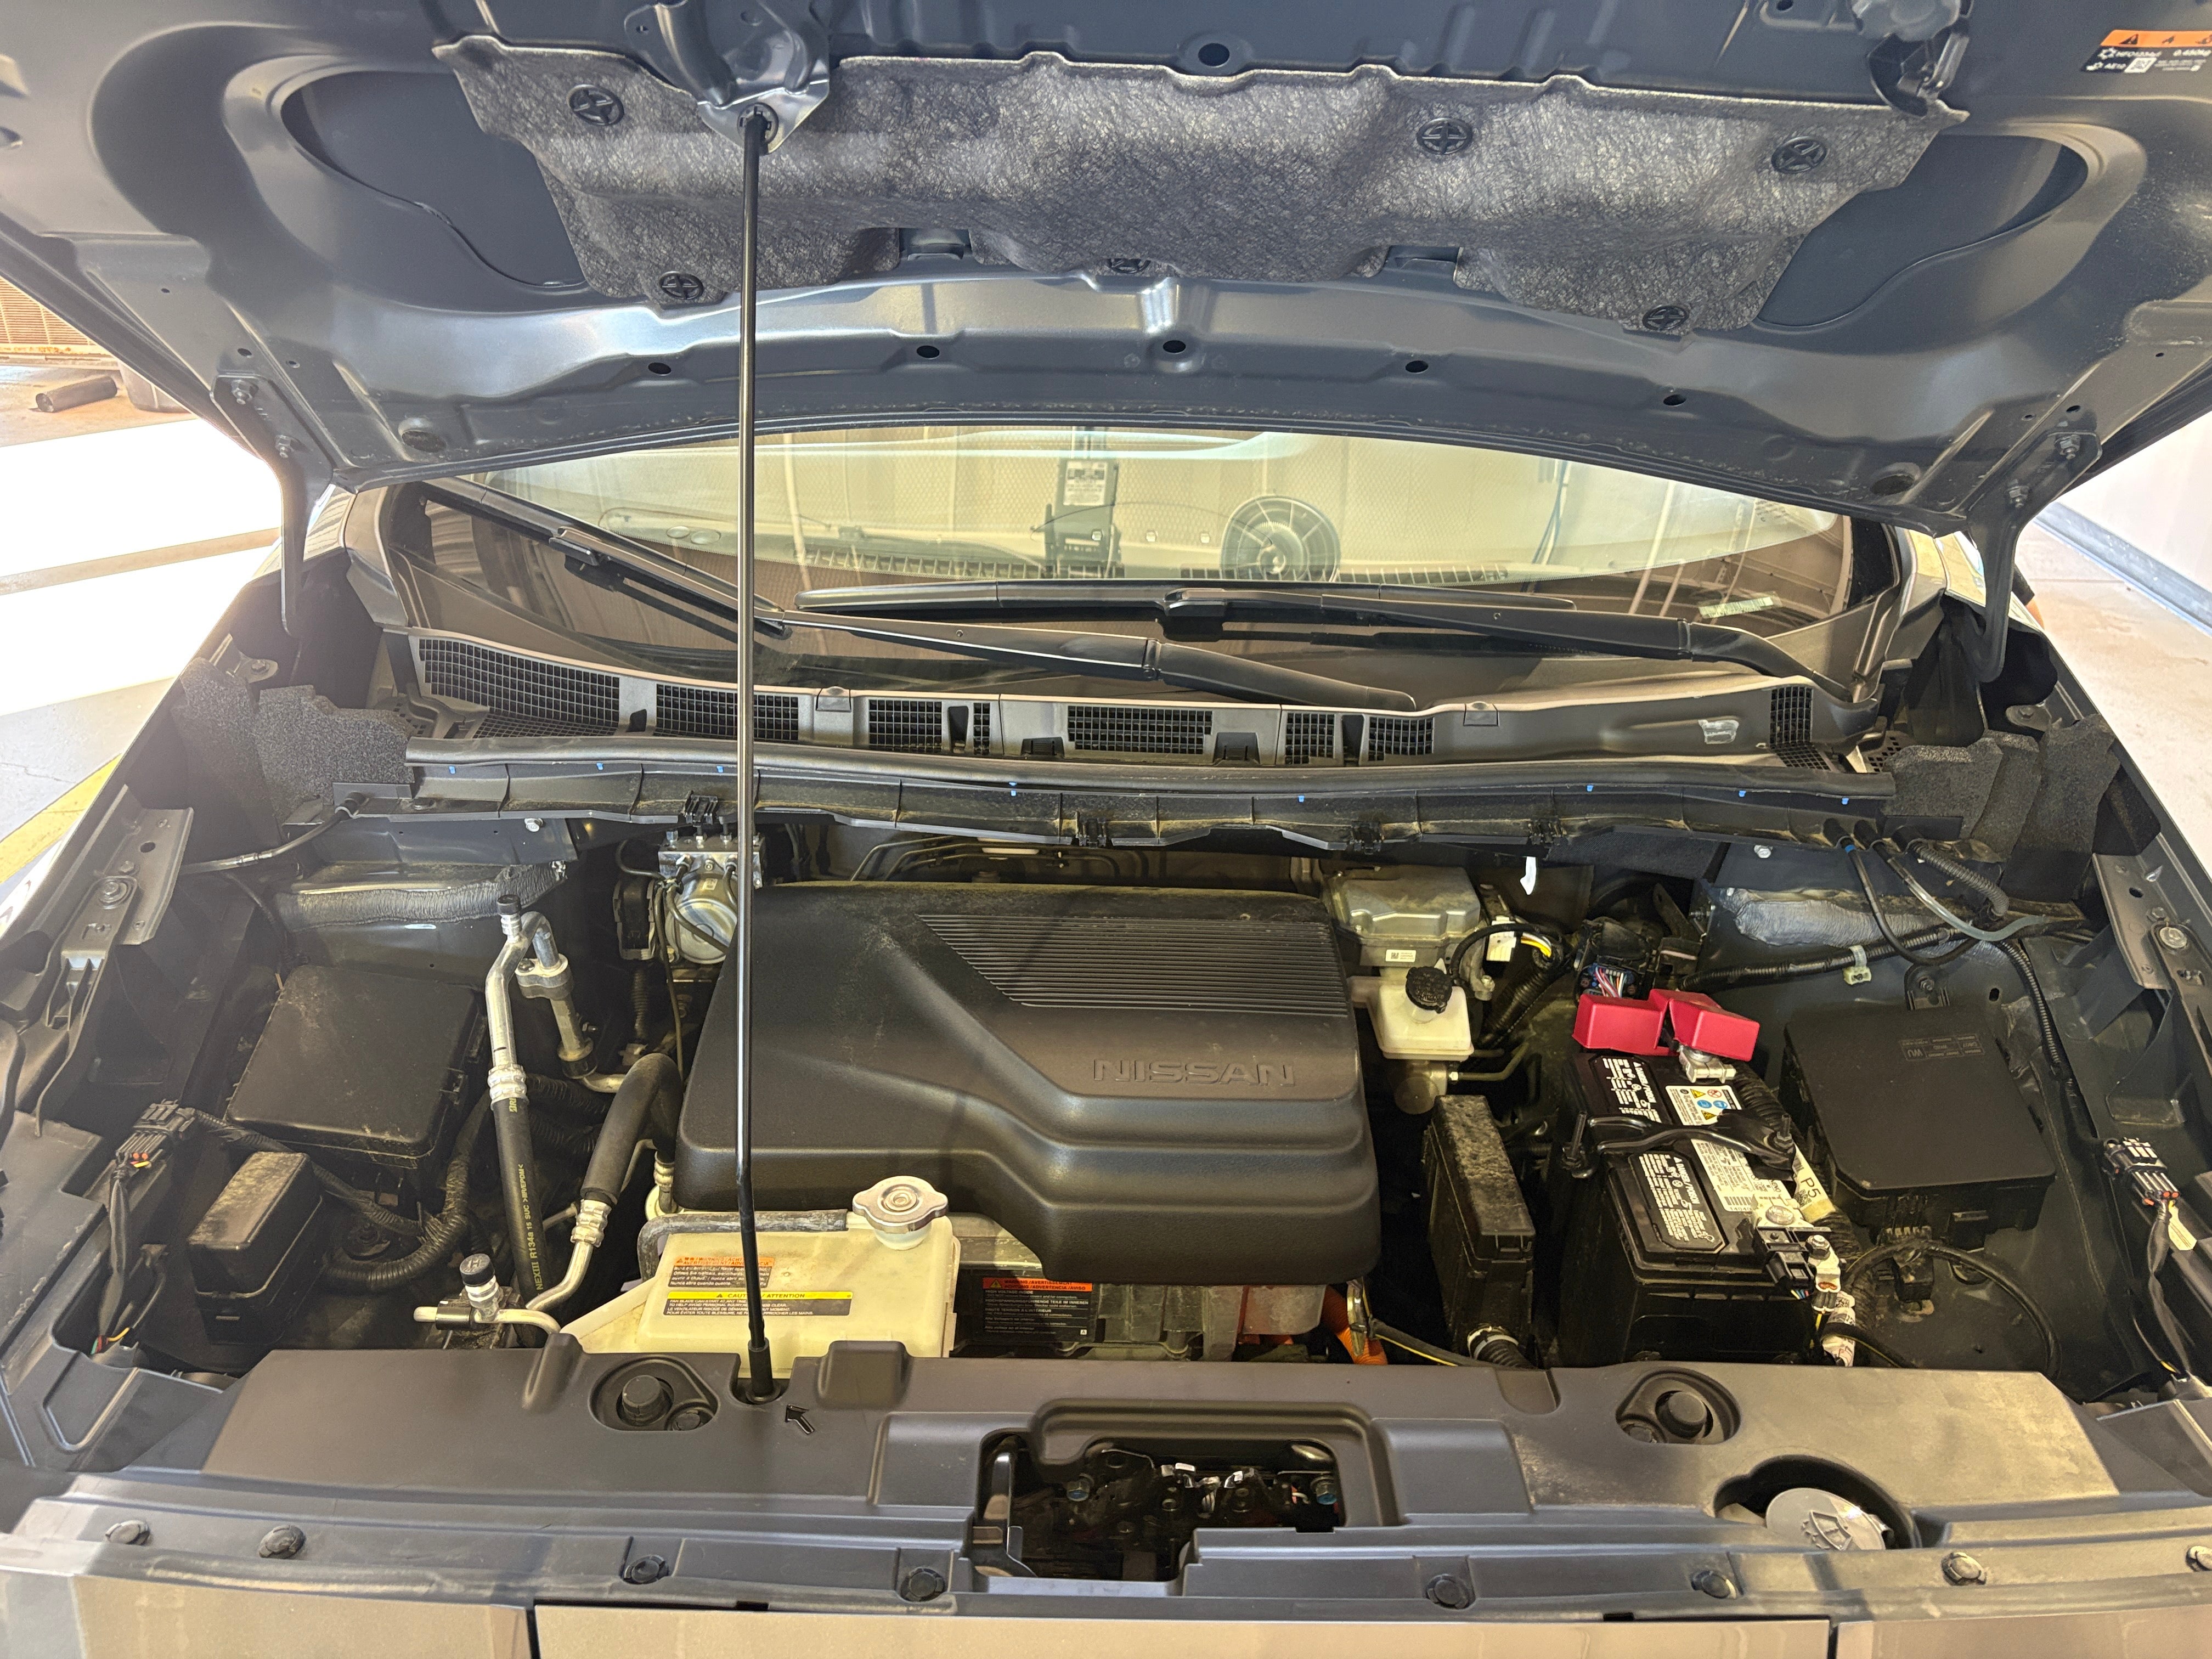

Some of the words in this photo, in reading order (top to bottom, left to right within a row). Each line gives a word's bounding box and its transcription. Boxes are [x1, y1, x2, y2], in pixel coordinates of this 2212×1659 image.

[1093, 1059, 1295, 1087] NISSAN
[1801, 1177, 1821, 1198] P5
[526, 1222, 533, 1230] 15
[527, 1232, 538, 1259] R134a
